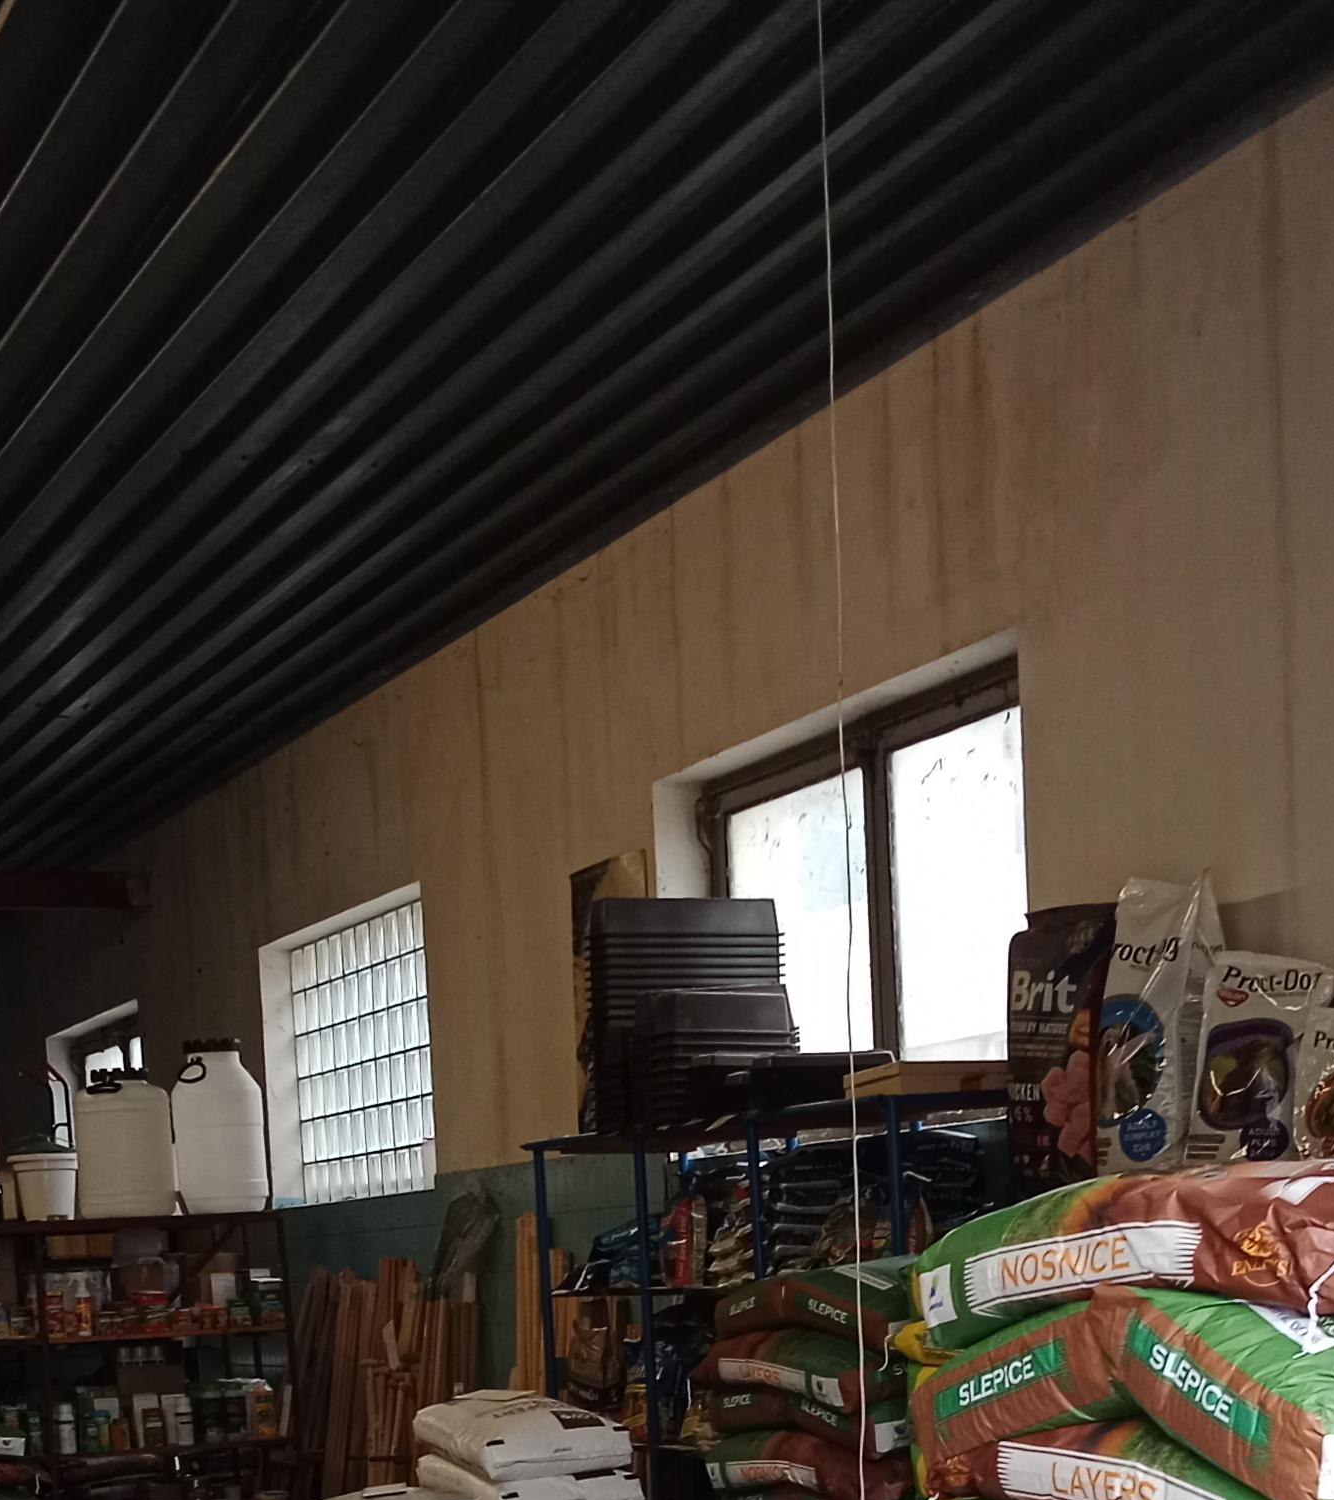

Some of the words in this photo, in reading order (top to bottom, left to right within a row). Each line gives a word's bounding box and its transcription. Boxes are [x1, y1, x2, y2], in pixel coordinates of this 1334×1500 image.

[1010, 970, 1077, 1014] Brit
[998, 1234, 1130, 1289] NOSNICE
[807, 1298, 849, 1325] SLEPICE
[957, 1355, 1036, 1408] SLEPICE
[1148, 1342, 1233, 1426] SLEPICE
